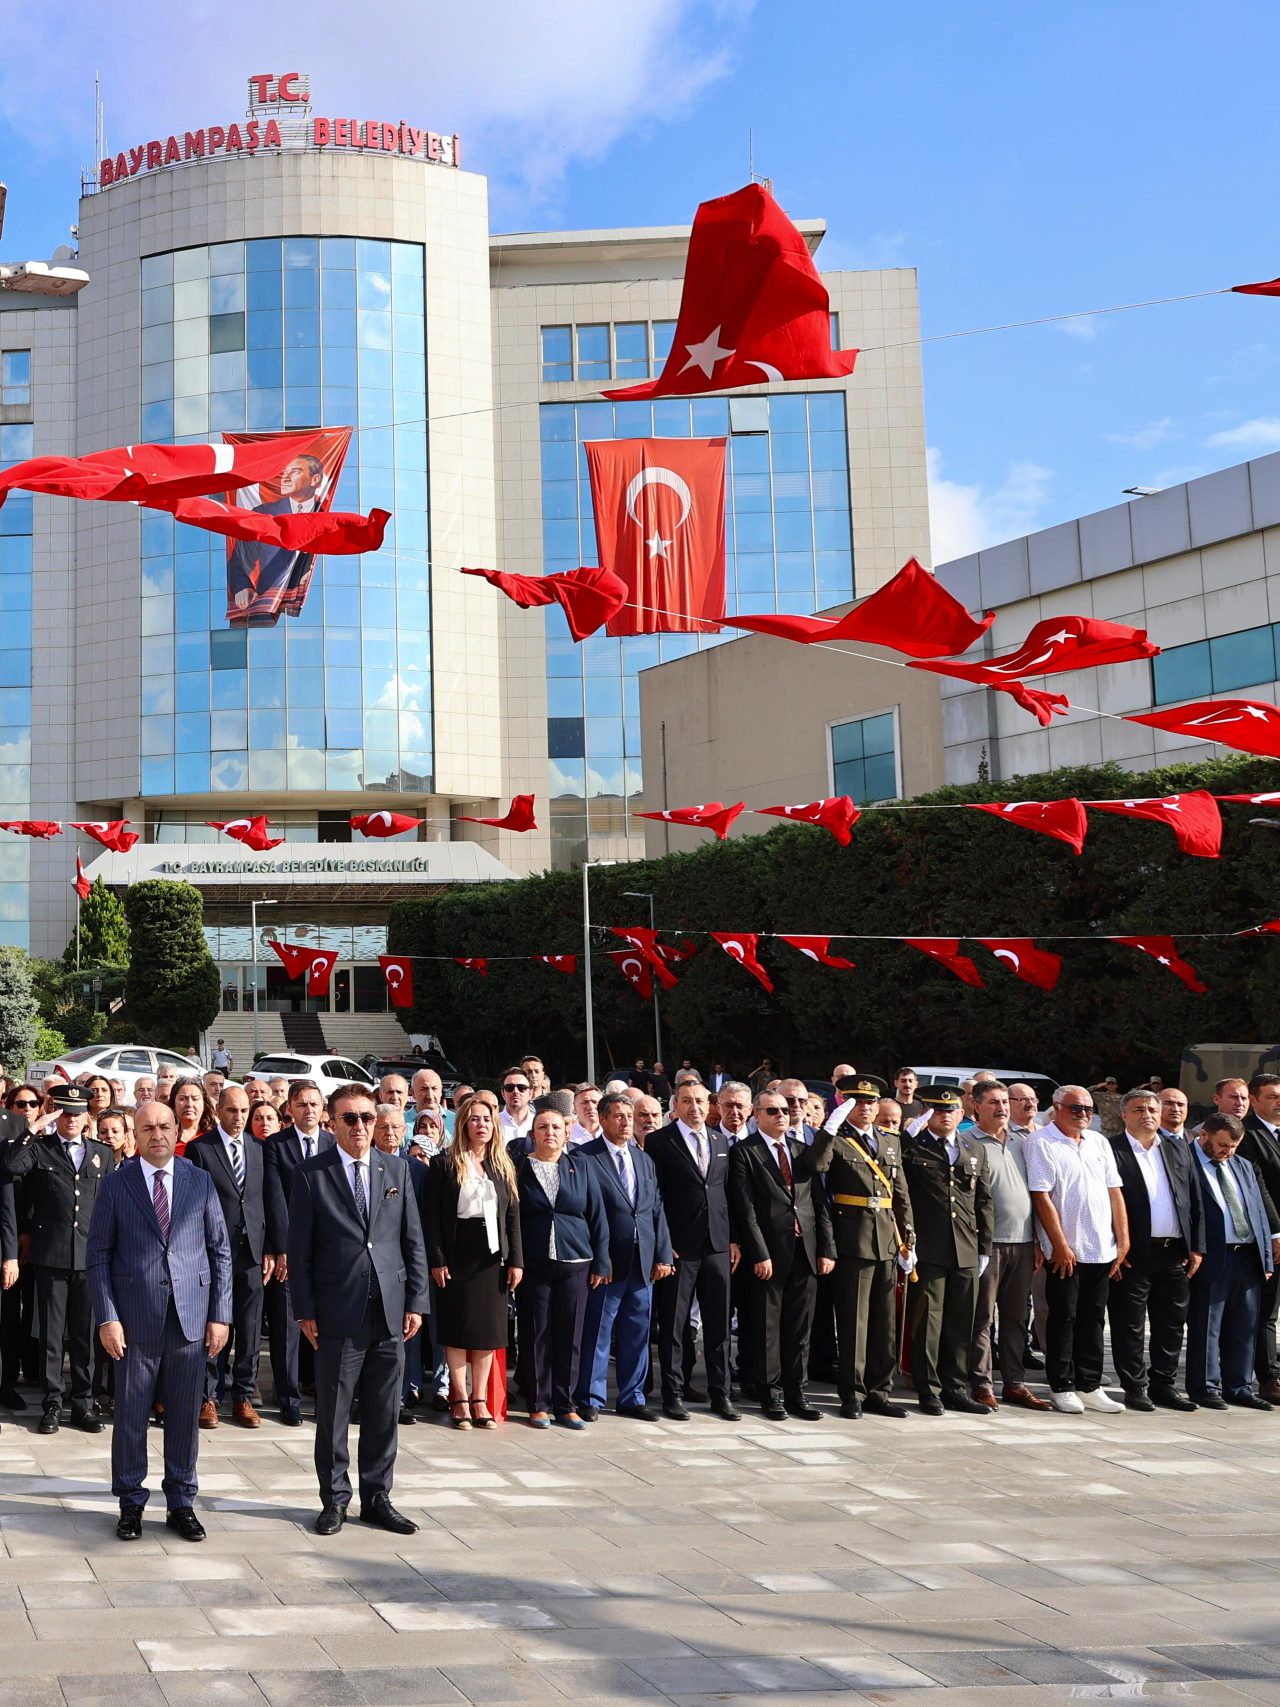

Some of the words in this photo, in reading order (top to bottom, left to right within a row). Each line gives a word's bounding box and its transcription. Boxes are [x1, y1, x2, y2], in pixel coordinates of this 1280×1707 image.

[250, 72, 311, 103] T.C.
[100, 118, 282, 187] BAYRAMPAŞA
[314, 116, 461, 168] BELEDİYESİ
[161, 861, 186, 875] T.C.
[281, 858, 346, 873] BELEDİYE
